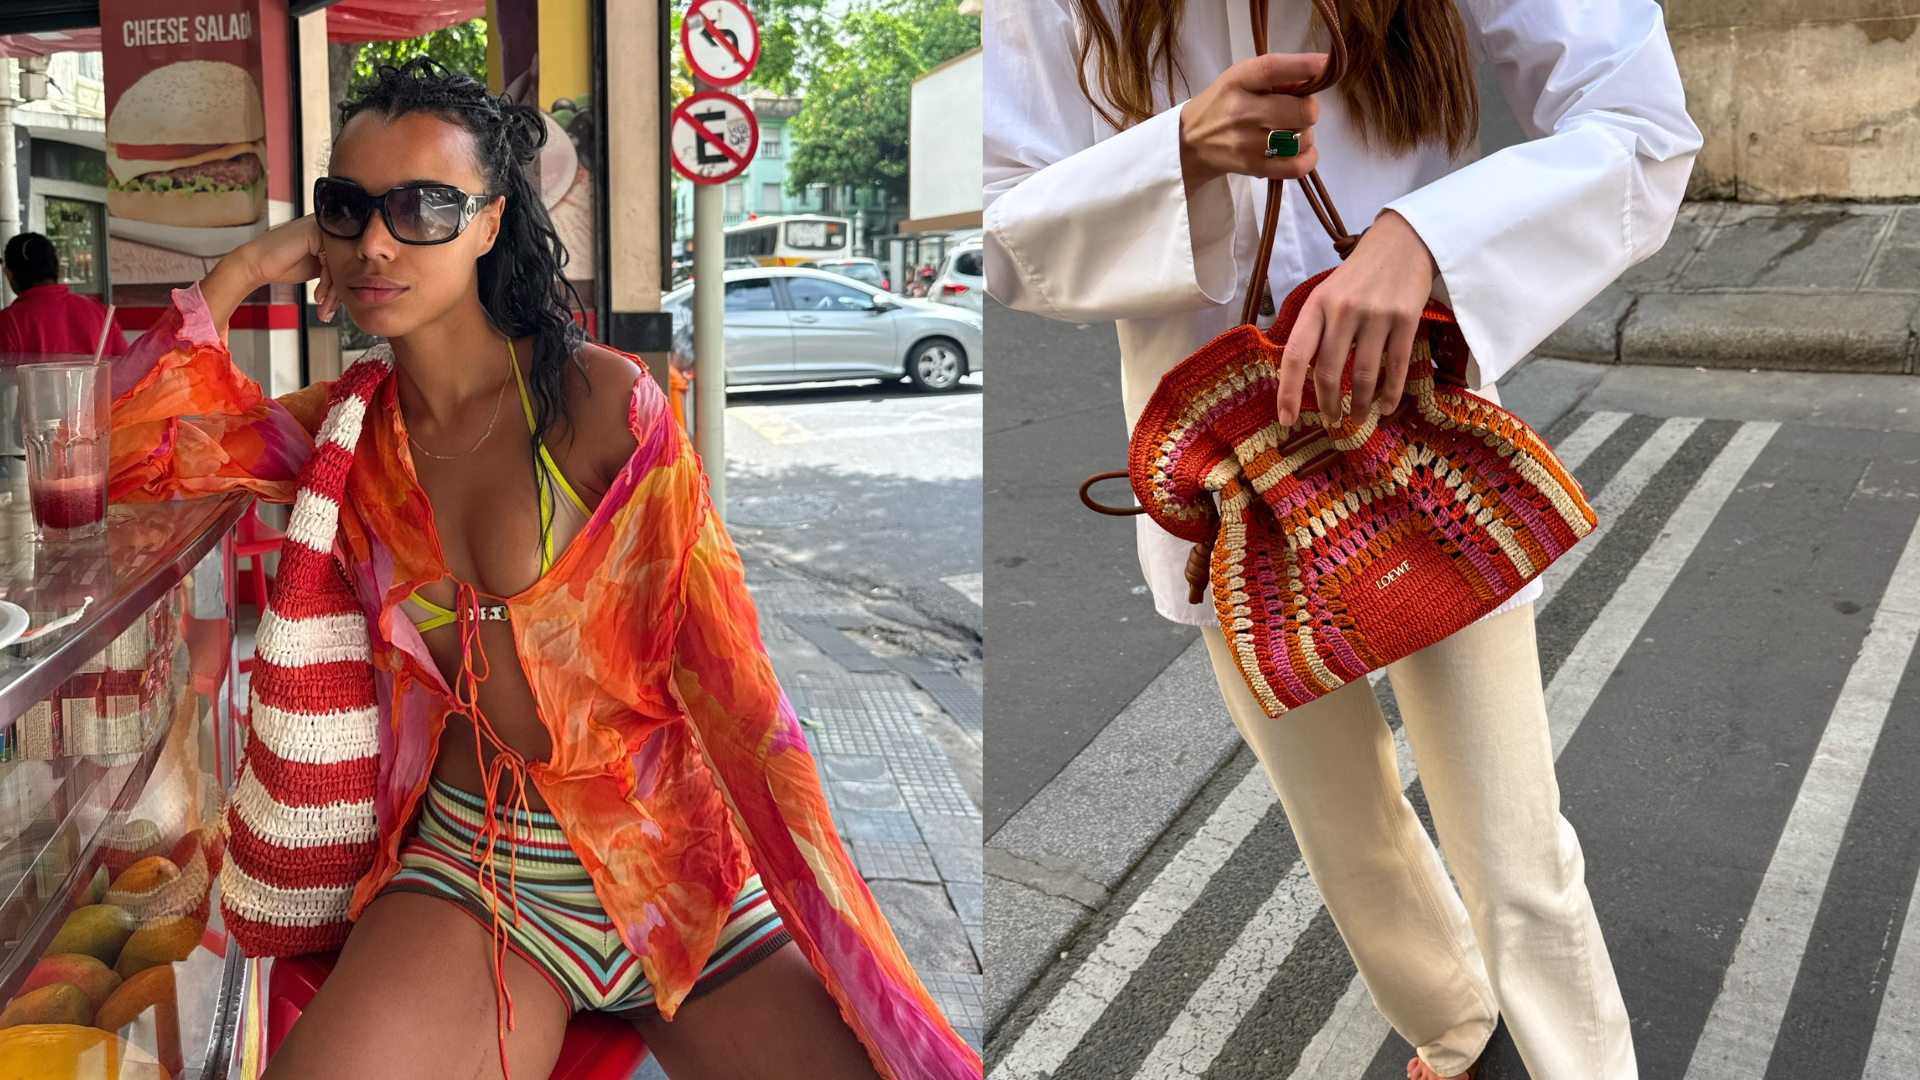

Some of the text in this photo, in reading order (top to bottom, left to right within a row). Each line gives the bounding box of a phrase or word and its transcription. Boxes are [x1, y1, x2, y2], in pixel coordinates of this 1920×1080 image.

[123, 17, 189, 47] CHEESE
[694, 110, 729, 165] E
[1375, 560, 1411, 590] LOEWE
